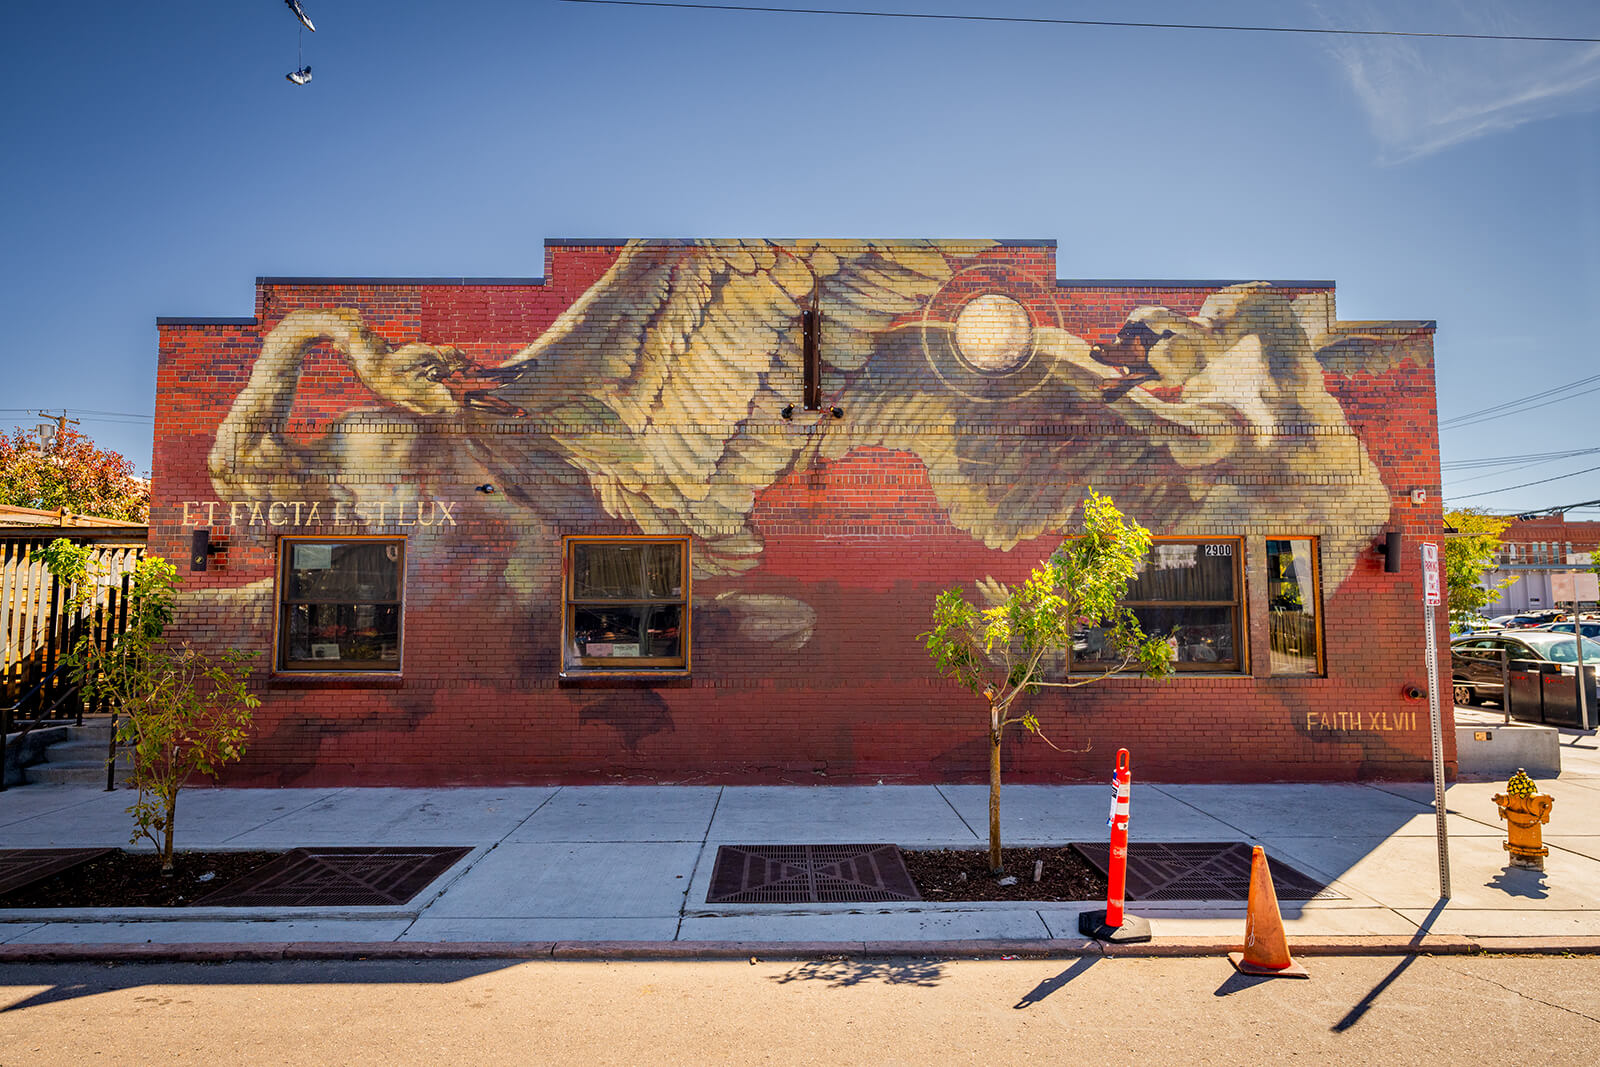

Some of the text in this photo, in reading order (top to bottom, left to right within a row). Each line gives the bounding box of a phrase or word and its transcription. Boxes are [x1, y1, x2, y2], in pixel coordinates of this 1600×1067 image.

[181, 501, 457, 526] ET FACTA EST LUX
[1205, 544, 1232, 556] 2900
[1306, 711, 1417, 731] FAITH XLVII
